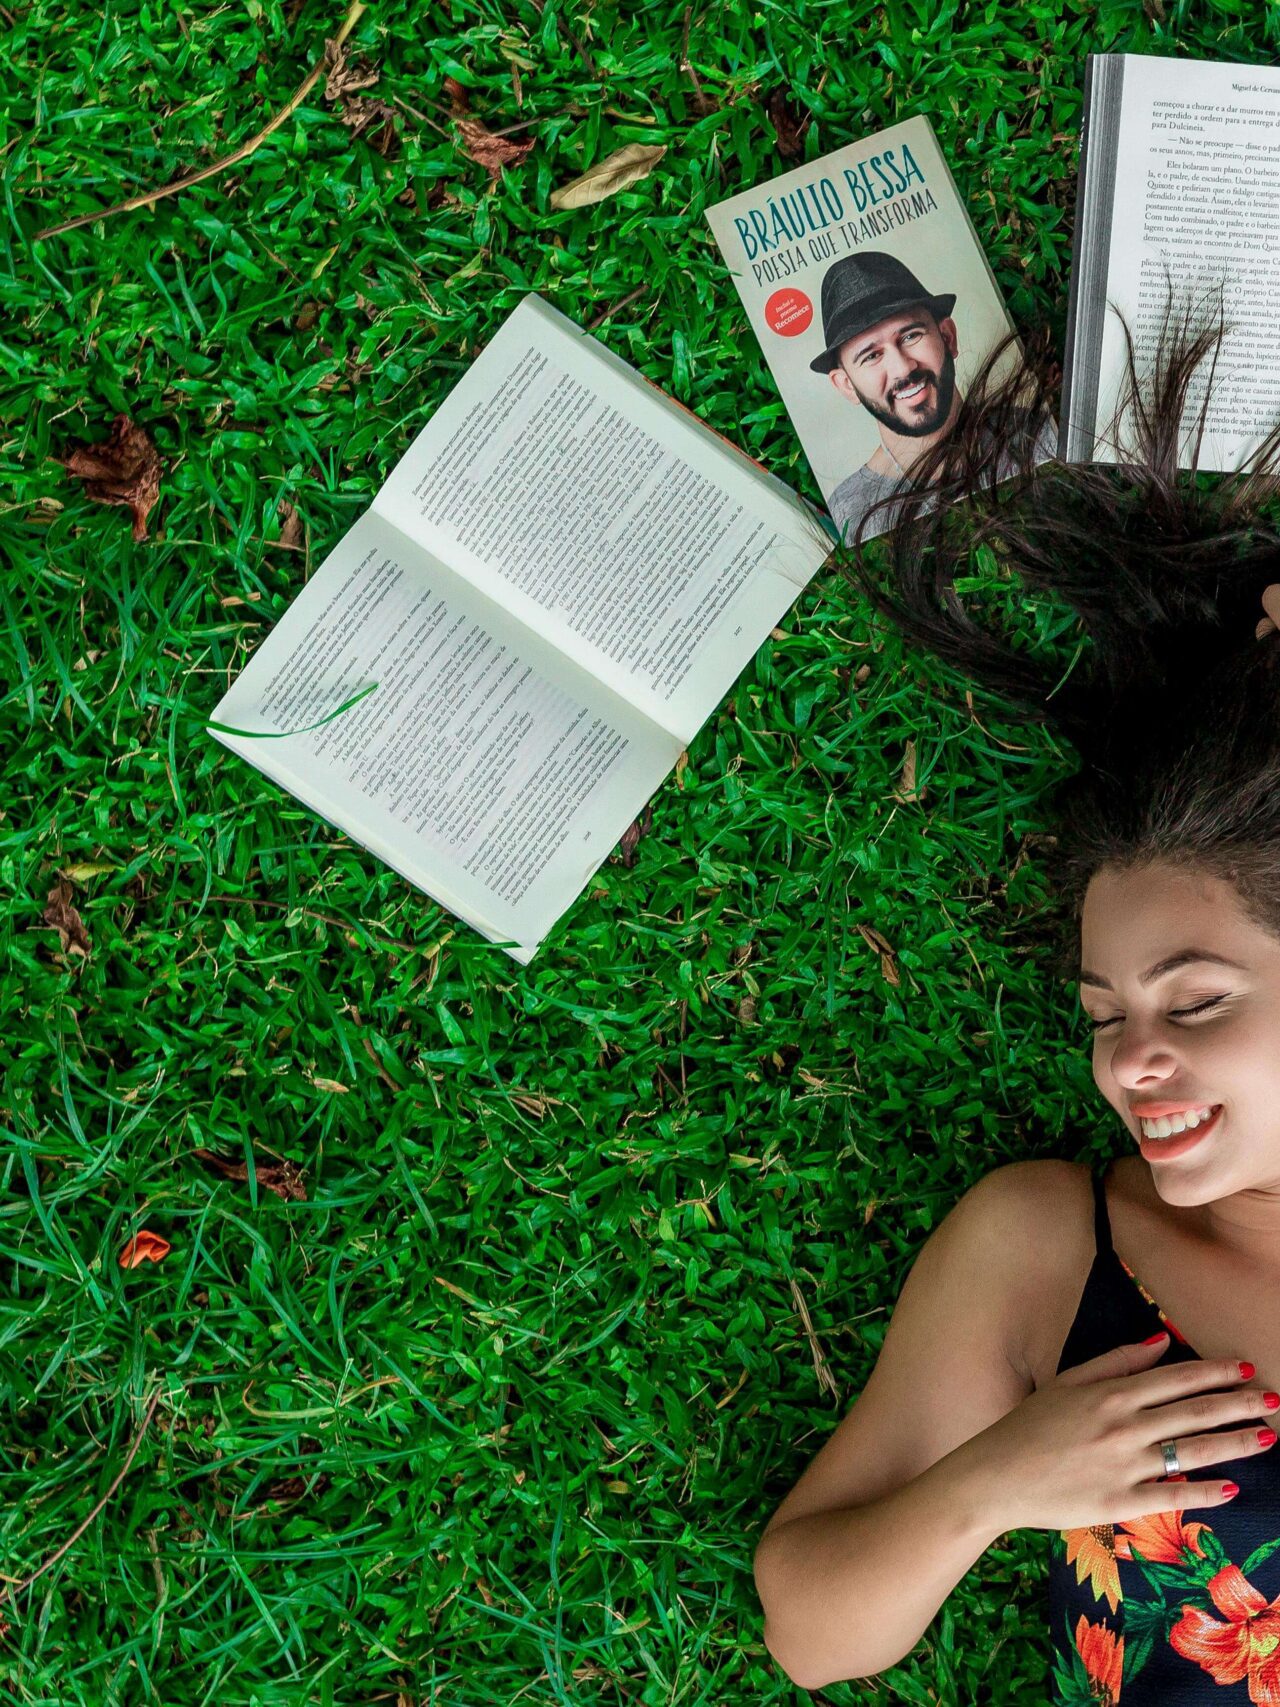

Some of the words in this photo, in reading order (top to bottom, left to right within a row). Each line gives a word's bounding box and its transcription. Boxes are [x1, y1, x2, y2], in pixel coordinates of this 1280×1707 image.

[1231, 82, 1251, 92] Miguel
[1152, 100, 1184, 110] começou
[1191, 101, 1214, 111] chorar
[1226, 104, 1238, 113] dar
[1239, 107, 1263, 115] murros
[1151, 109, 1162, 117] ter
[1163, 110, 1192, 122] perdido
[1200, 113, 1223, 122] ordem
[1224, 117, 1240, 126] para
[1248, 116, 1273, 128] entrega
[1151, 122, 1166, 130] para
[1168, 121, 1206, 131] Dulcineia.
[1166, 159, 1181, 168] Eles
[1181, 161, 1209, 171] bolaram
[1222, 164, 1244, 175] plano.
[1252, 166, 1279, 176] barbeiro
[734, 178, 843, 260] BRÁULIO
[844, 144, 925, 212] BESSA
[1144, 211, 1162, 221] Com
[1163, 213, 1180, 222] tudo
[1180, 214, 1220, 227] combinado,
[1225, 218, 1244, 229] padre
[752, 245, 808, 287] POESIA
[808, 233, 841, 262] QUE
[841, 188, 938, 248] TRANSFORMA
[774, 304, 810, 330] Recomece
[779, 304, 798, 319] poema
[733, 625, 742, 636] 207
